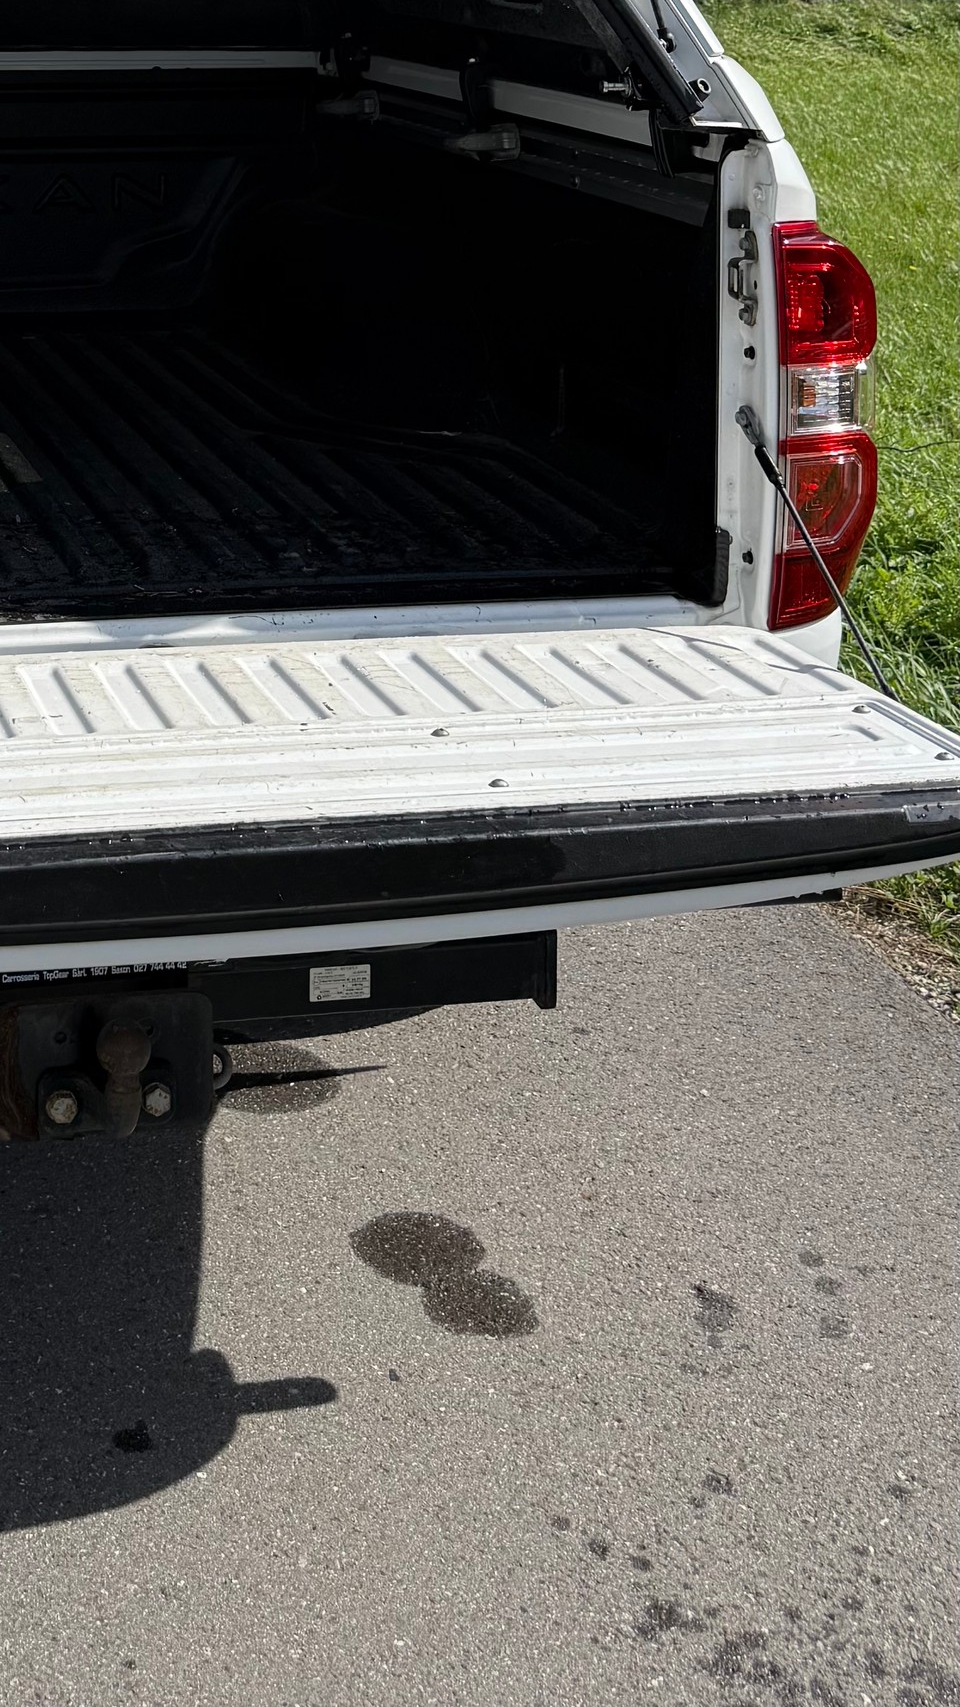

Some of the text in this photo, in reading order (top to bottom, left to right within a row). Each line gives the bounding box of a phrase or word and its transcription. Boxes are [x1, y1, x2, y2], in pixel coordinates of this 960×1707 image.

[133, 963, 147, 973] 027
[150, 962, 164, 972] 744
[165, 962, 175, 970] 44
[176, 961, 188, 969] 42
